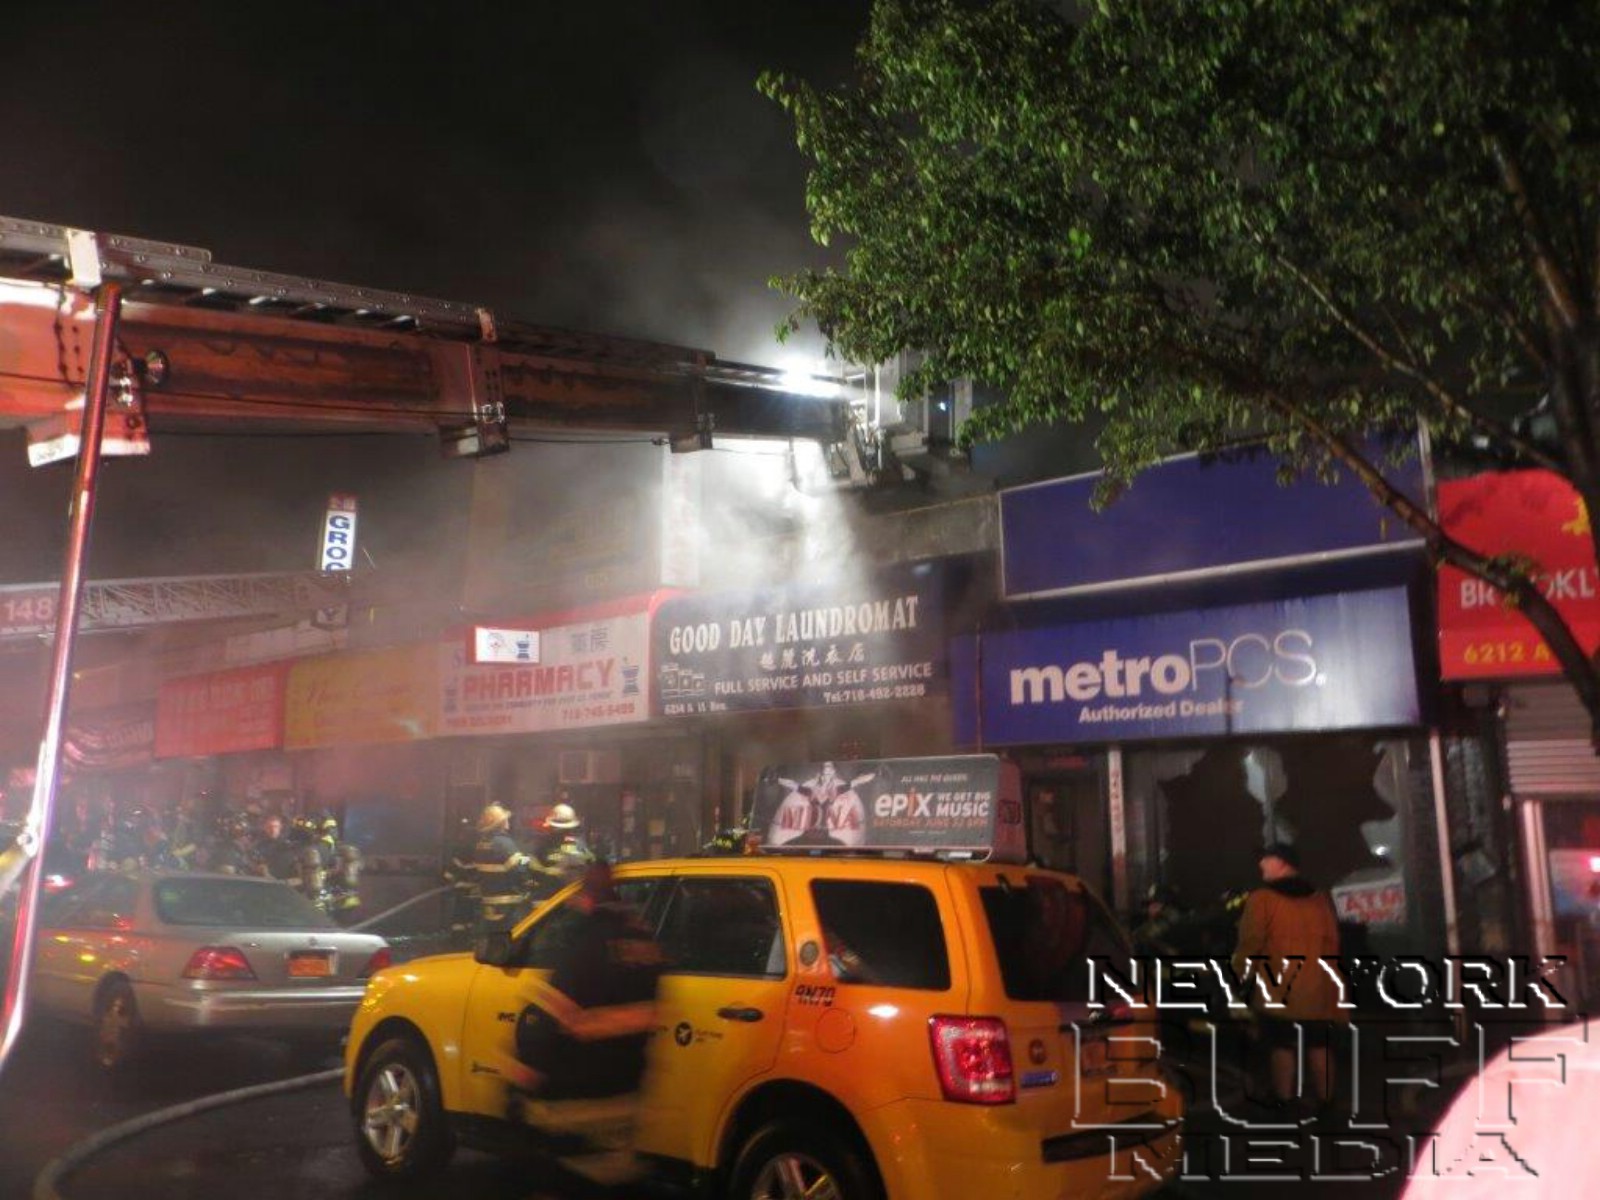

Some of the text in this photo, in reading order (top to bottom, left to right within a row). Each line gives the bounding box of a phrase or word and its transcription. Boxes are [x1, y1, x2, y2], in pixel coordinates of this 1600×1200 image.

[669, 596, 918, 655] GOOD DAY LAUNDROMAT
[1463, 643, 1525, 664] 6212
[462, 658, 615, 700] PHARMACY
[714, 680, 744, 696] FULL
[747, 675, 798, 693] SERVICE
[802, 672, 832, 687] AND
[837, 668, 867, 685] SELF
[872, 662, 932, 682] SERVICE
[1079, 701, 1176, 723] Authorized
[936, 801, 989, 817] MUSIC
